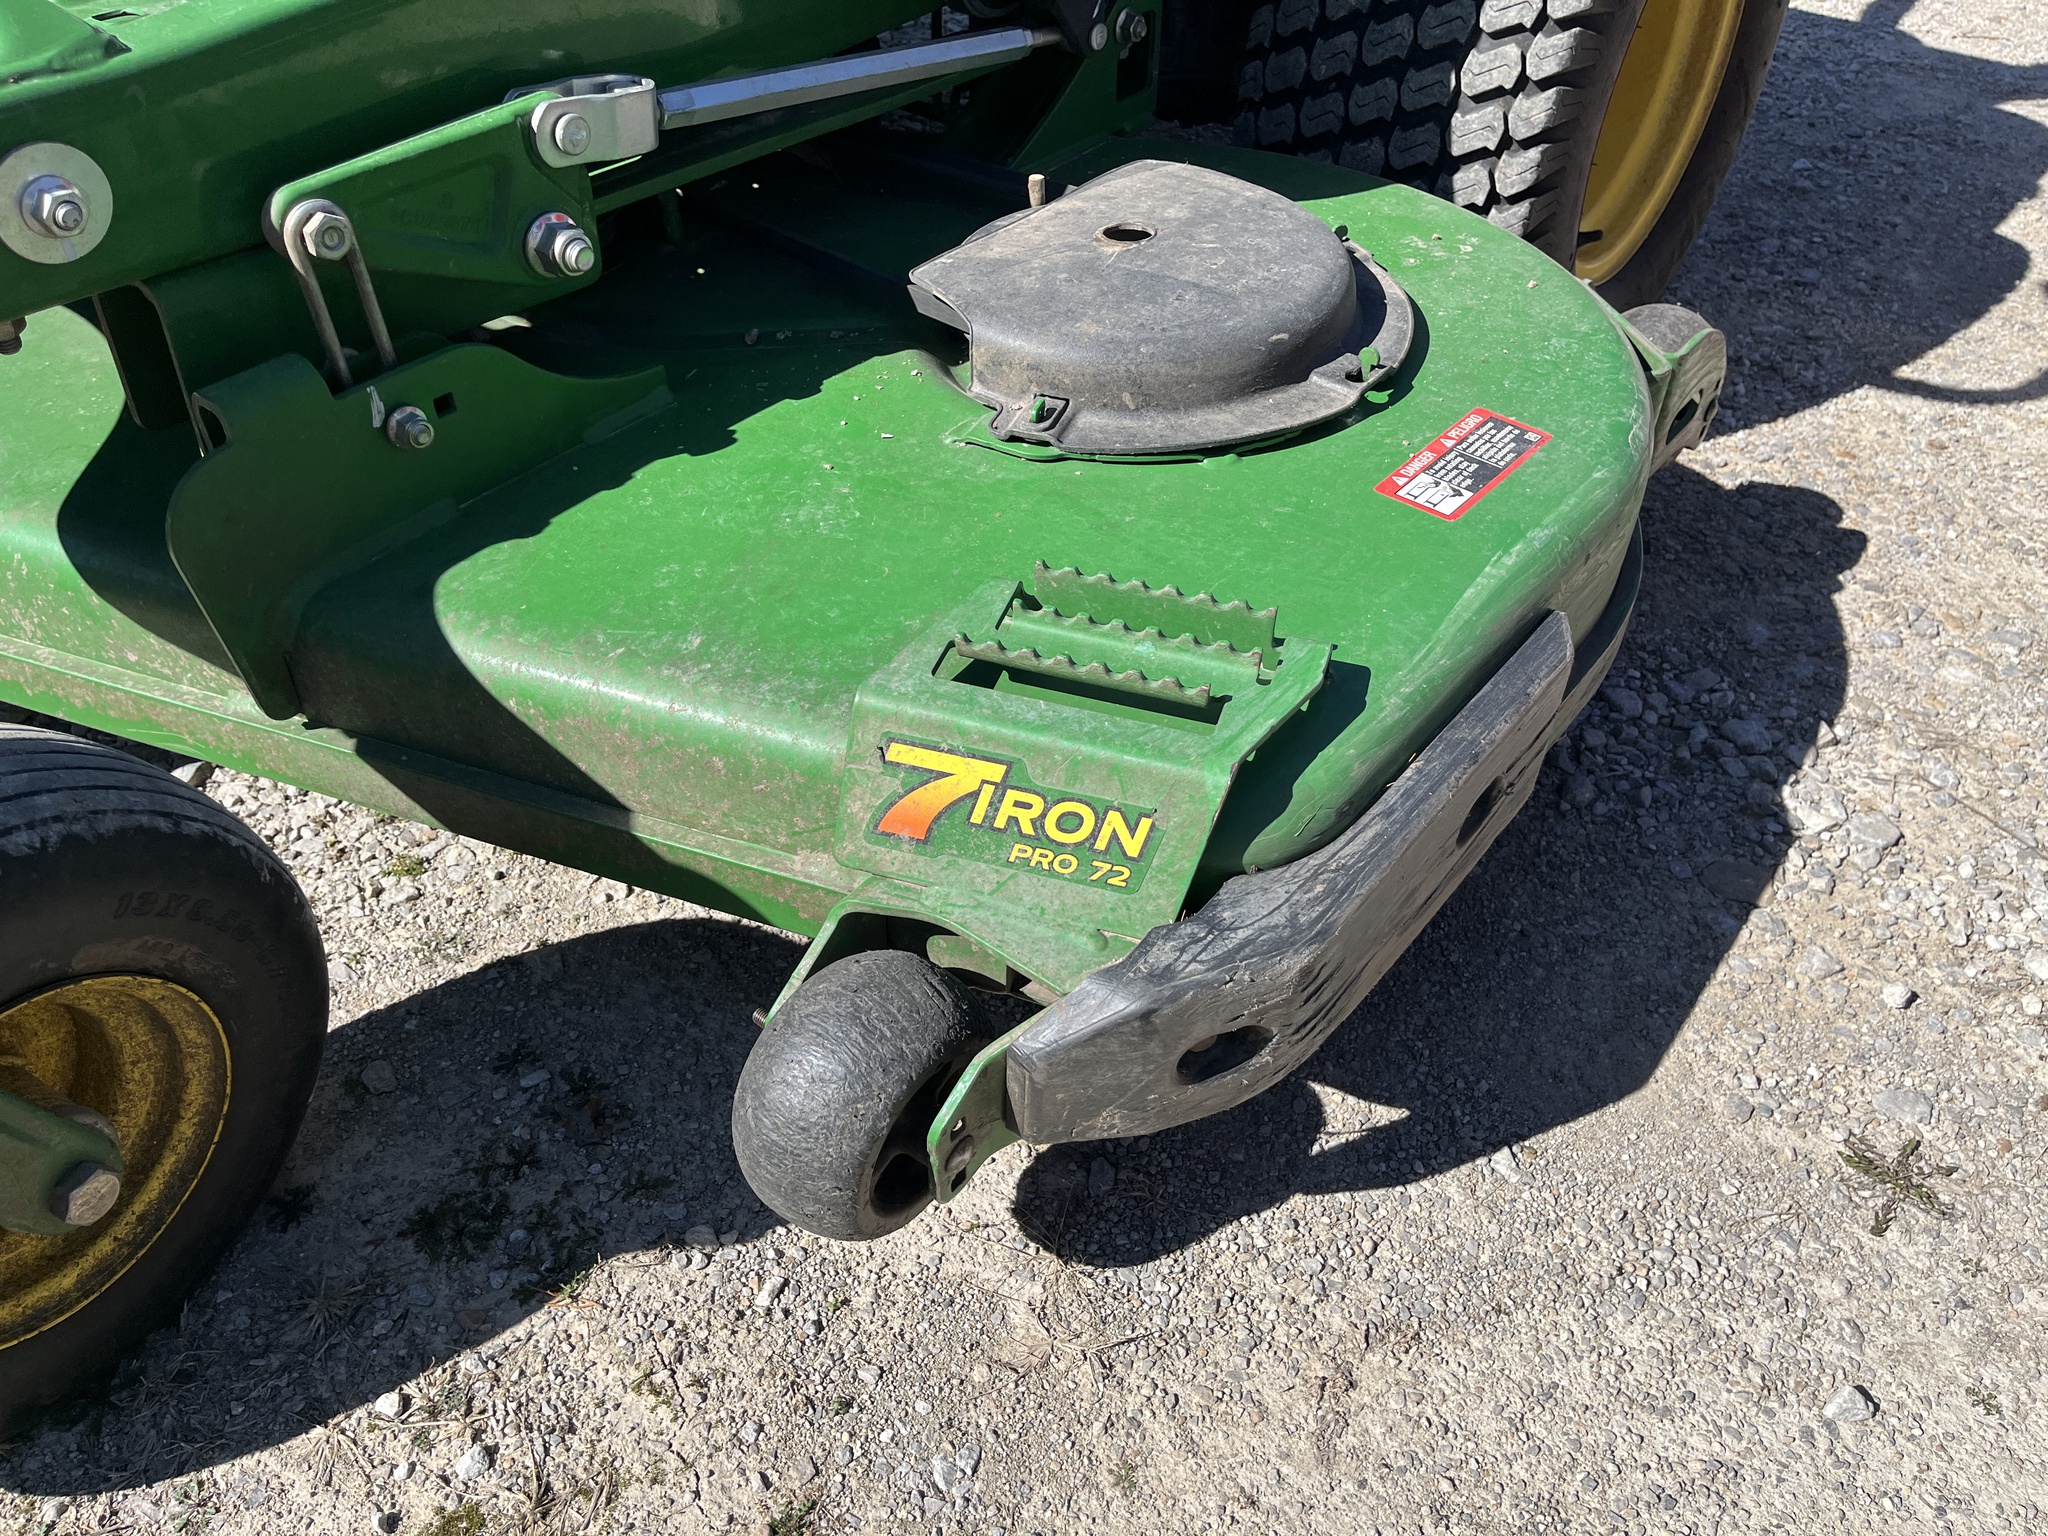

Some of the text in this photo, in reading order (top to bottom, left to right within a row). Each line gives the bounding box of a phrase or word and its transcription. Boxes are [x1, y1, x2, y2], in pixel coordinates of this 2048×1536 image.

[1447, 414, 1483, 439] PELIGRO
[1400, 451, 1437, 476] DANGER
[1433, 459, 1446, 470] avoid
[1442, 451, 1459, 461] injury
[876, 740, 1153, 859] 7 IRON
[1007, 843, 1131, 889] PRO 72
